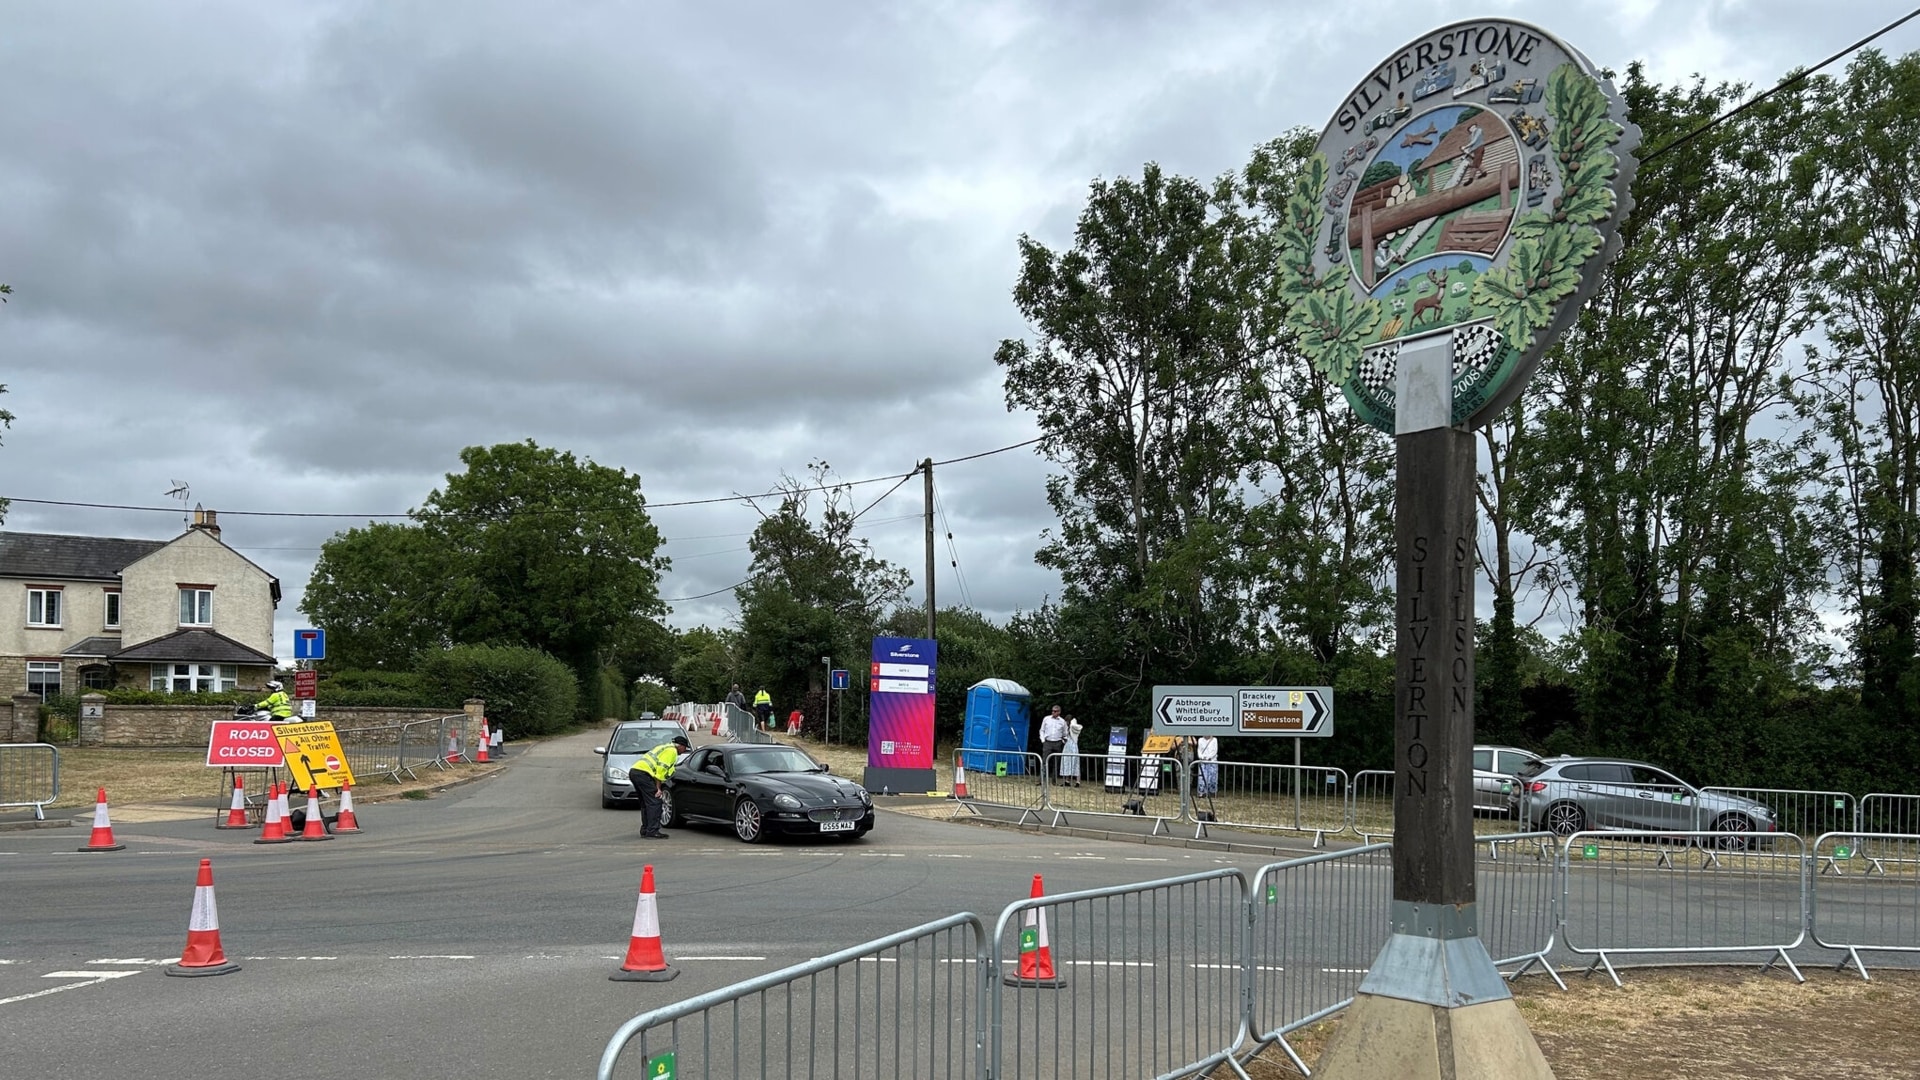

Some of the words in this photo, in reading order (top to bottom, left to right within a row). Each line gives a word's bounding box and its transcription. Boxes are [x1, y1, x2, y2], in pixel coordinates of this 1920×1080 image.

[1337, 26, 1543, 134] SILVERSTONE
[1350, 378, 1396, 422] SILVERSTON
[1452, 387, 1479, 410] RACE
[1479, 342, 1512, 389] CIRCUIT
[1453, 369, 1481, 398] 2008
[1371, 416, 1395, 432] SIXT
[1452, 536, 1468, 713] SILSON
[1406, 536, 1429, 797] SILVERTON
[1175, 699, 1211, 707] Abthorpe
[1242, 693, 1276, 701] Brackley
[1242, 700, 1280, 708] Syresham
[90, 707, 96, 715] 2
[1175, 707, 1221, 715] Whittlebury
[1257, 715, 1301, 723] Silverstone
[229, 729, 270, 741] ROAD
[276, 723, 326, 735] Silverstone
[312, 734, 331, 742] Other
[219, 746, 275, 758] CLOSED
[307, 743, 330, 751] Traffic
